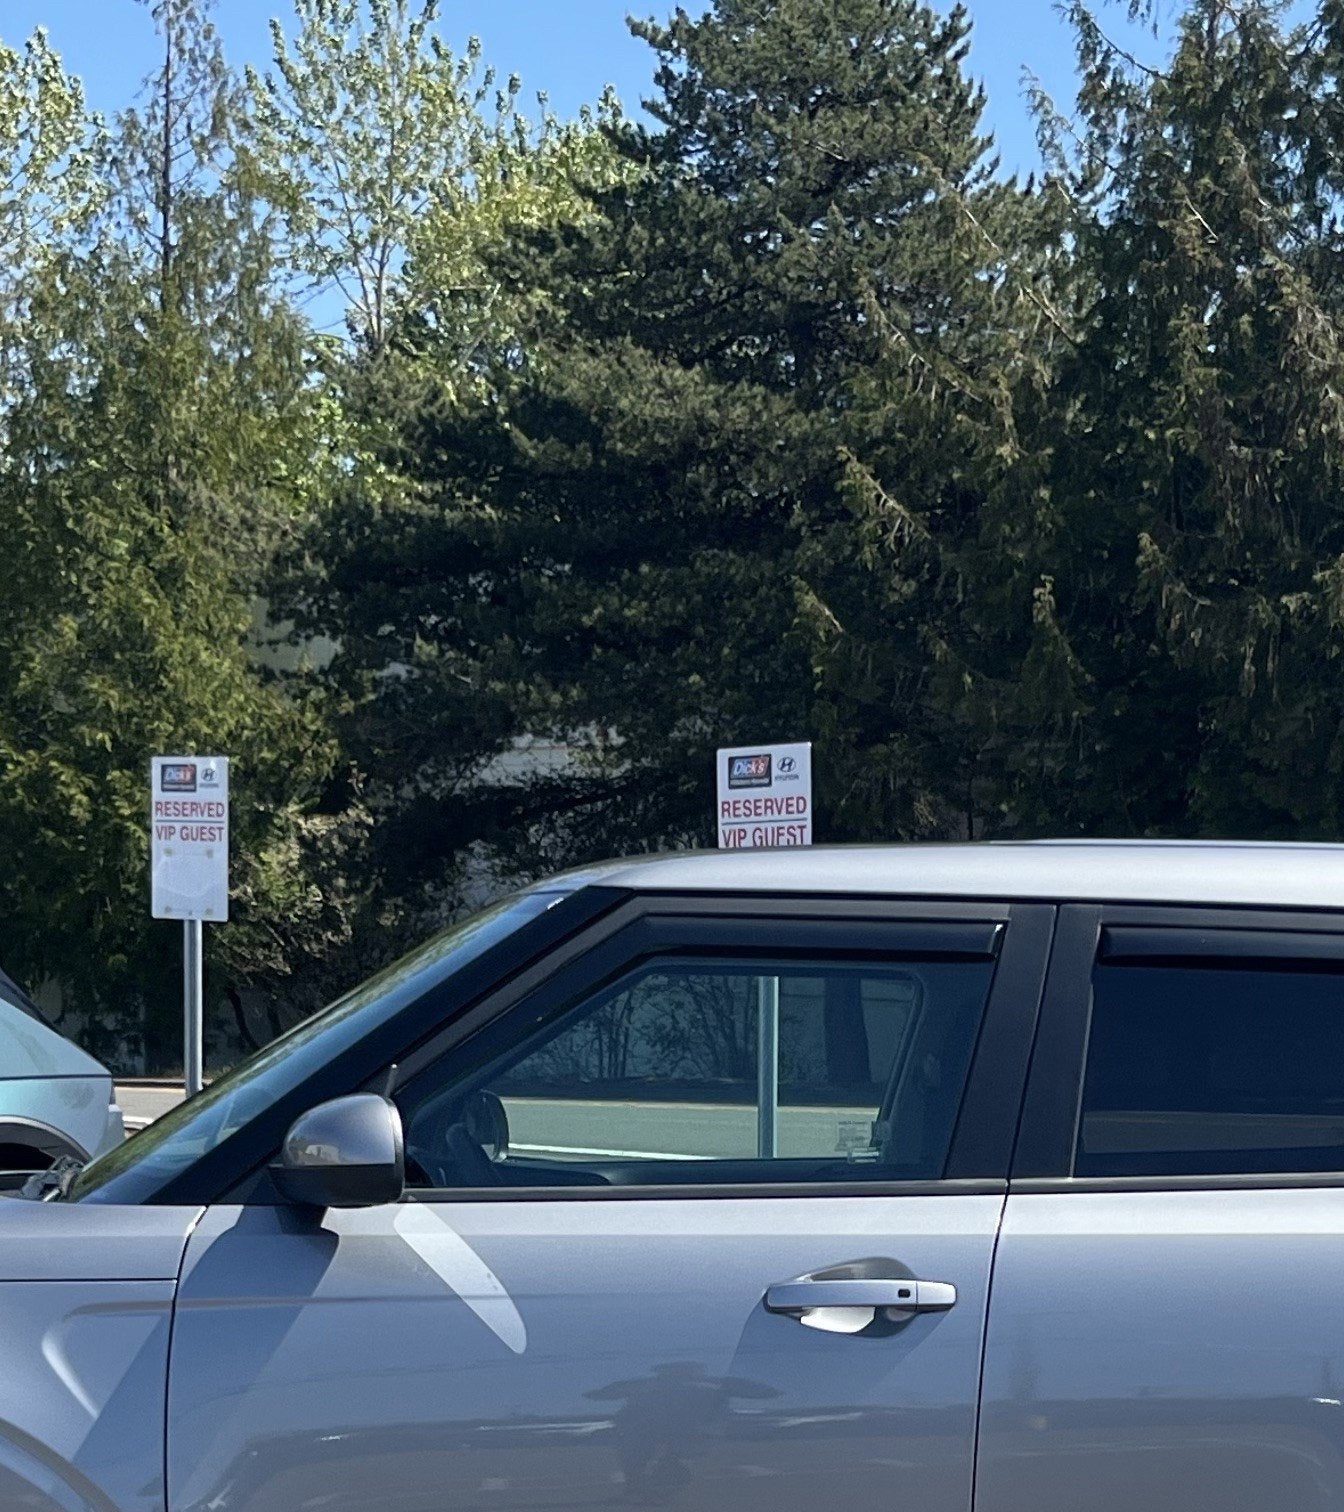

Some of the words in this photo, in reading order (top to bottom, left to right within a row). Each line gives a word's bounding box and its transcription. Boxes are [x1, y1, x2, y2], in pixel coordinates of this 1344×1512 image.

[155, 801, 225, 818] RESERVED
[721, 796, 807, 819] RESERVED
[155, 825, 176, 841] VIP
[179, 826, 225, 842] GUEST
[722, 827, 747, 848] VIP
[752, 825, 807, 847] GUEST
